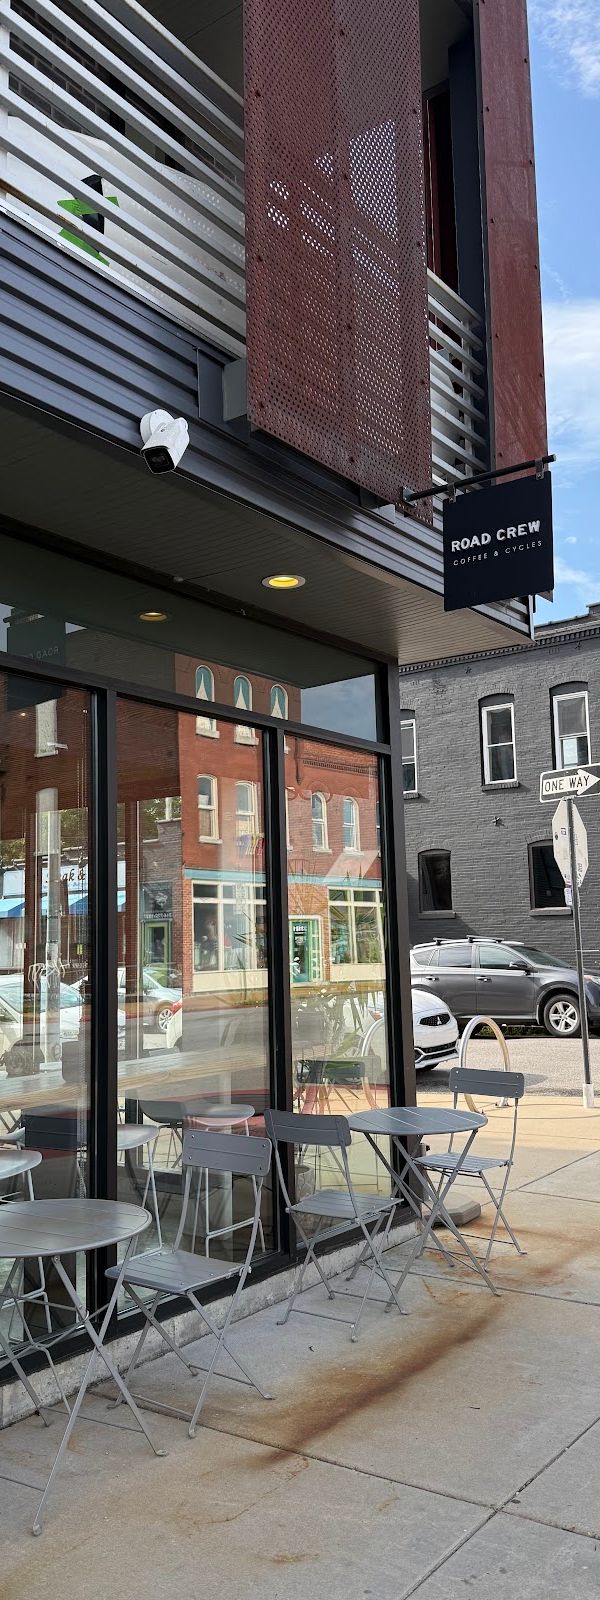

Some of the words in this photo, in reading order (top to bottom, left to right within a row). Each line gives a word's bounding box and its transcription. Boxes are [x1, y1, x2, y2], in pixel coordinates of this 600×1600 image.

[451, 533, 492, 552] ROAD
[496, 520, 541, 541] CREW
[453, 552, 488, 566] COFFEE
[504, 540, 542, 554] CYCLES
[544, 779, 565, 792] ONE
[569, 775, 590, 789] WAY
